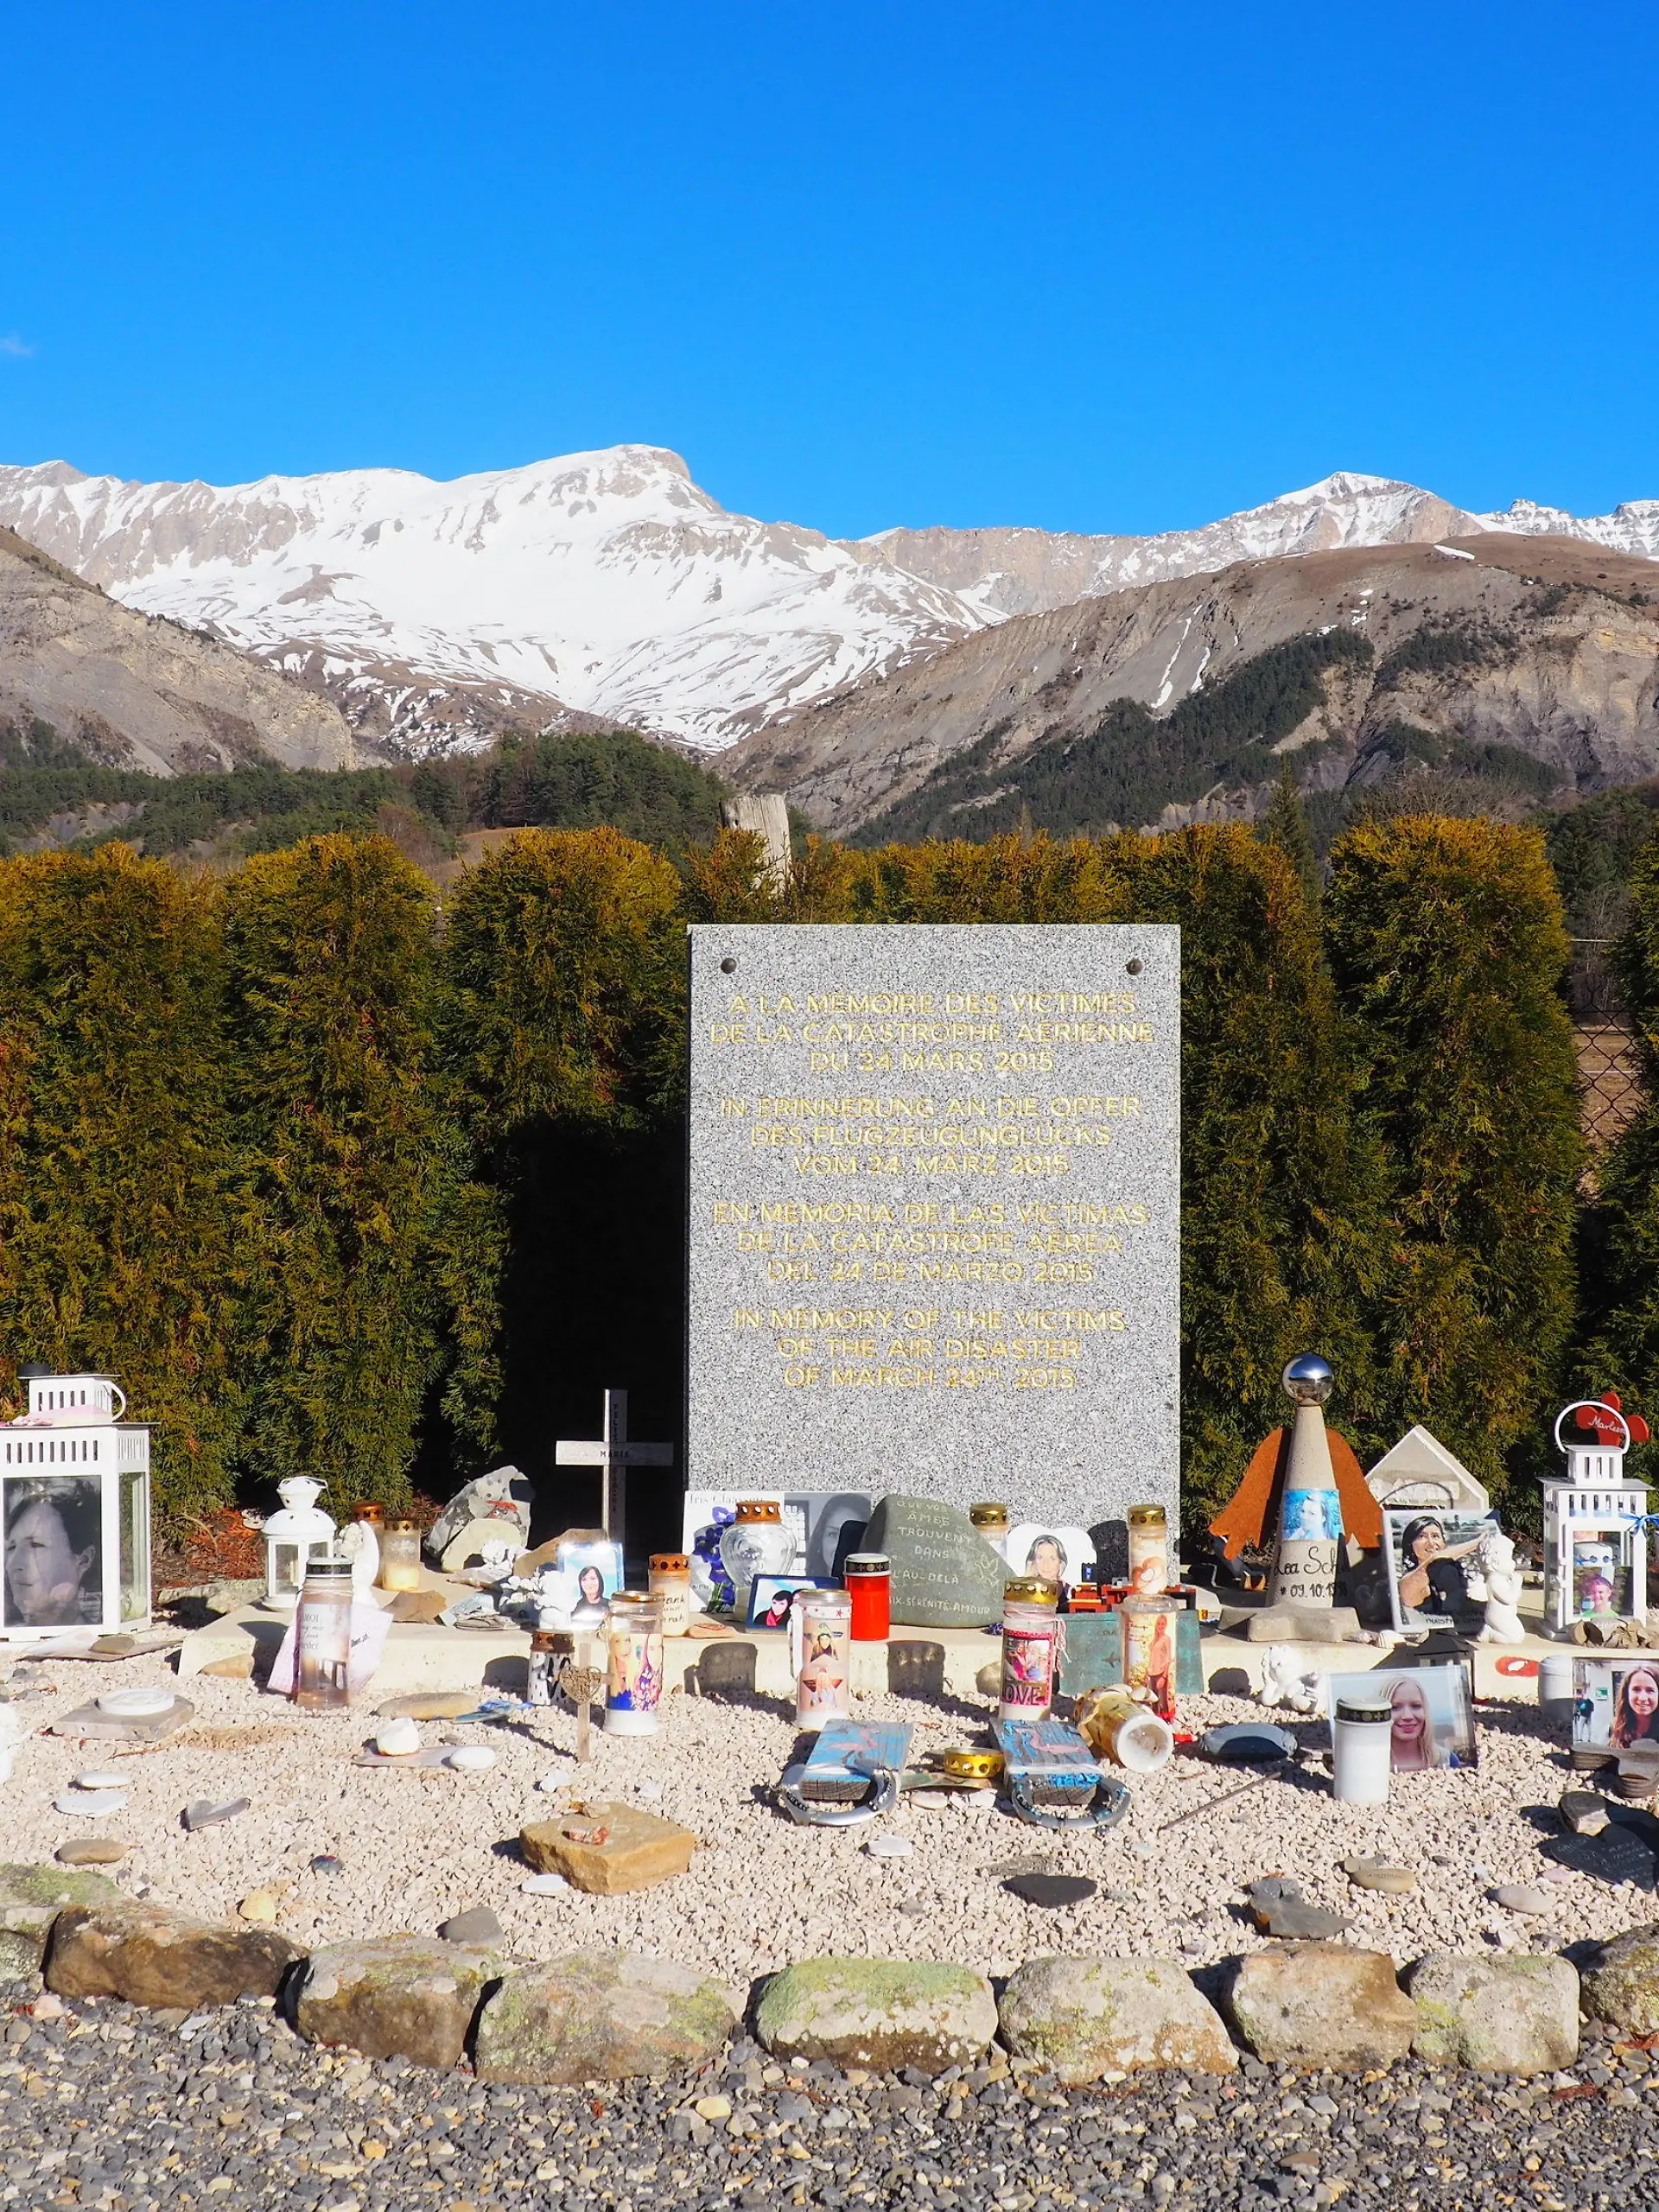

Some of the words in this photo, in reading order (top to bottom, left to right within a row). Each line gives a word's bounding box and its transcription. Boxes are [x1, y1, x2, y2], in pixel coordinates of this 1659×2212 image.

[730, 993, 751, 1014] A
[760, 993, 796, 1014] LA
[946, 993, 1001, 1014] DES
[1013, 993, 1135, 1014] VICTIMES
[710, 1021, 747, 1043] DE
[756, 1021, 794, 1043] LA
[803, 1021, 1003, 1043] CATASTROPHE
[810, 1051, 849, 1071] DU
[861, 1051, 893, 1071] 24
[902, 1051, 984, 1071] MARS
[995, 1051, 1054, 1071] 2015
[722, 1097, 747, 1118] IN
[758, 1097, 935, 1118] ERINNERUNG
[947, 1097, 988, 1118] AN
[997, 1097, 1041, 1118] DIE
[1050, 1097, 1141, 1118] OPFER
[752, 1126, 805, 1147] DES
[794, 1154, 859, 1174] VOM
[1010, 1154, 1070, 1174] 2015
[714, 1203, 752, 1224] EN
[760, 1203, 893, 1224] MEMORIA
[904, 1203, 940, 1224] DE
[950, 1203, 1007, 1224] LAS
[738, 1232, 774, 1253] DE
[785, 1232, 823, 1253] LA
[768, 1262, 818, 1282] DEL
[830, 1262, 864, 1282] 24
[873, 1262, 908, 1282] DE
[919, 1262, 1025, 1282] MARZO
[1033, 1262, 1094, 1282] 2015
[734, 1309, 762, 1331] IN
[771, 1309, 895, 1331] MEMORY
[904, 1309, 941, 1331] OF
[953, 1309, 1005, 1331] THE
[1014, 1309, 1127, 1331] VICTIMS
[778, 1338, 815, 1359] OF
[826, 1338, 878, 1359] THE
[887, 1338, 935, 1359] AIR
[945, 1338, 1081, 1359] DISASTER
[784, 1367, 822, 1388] OF
[831, 1367, 937, 1388] MARCH
[1015, 1367, 1077, 1388] 2015
[914, 1545, 950, 1558] DANS
[1002, 1683, 1040, 1706] OVE
